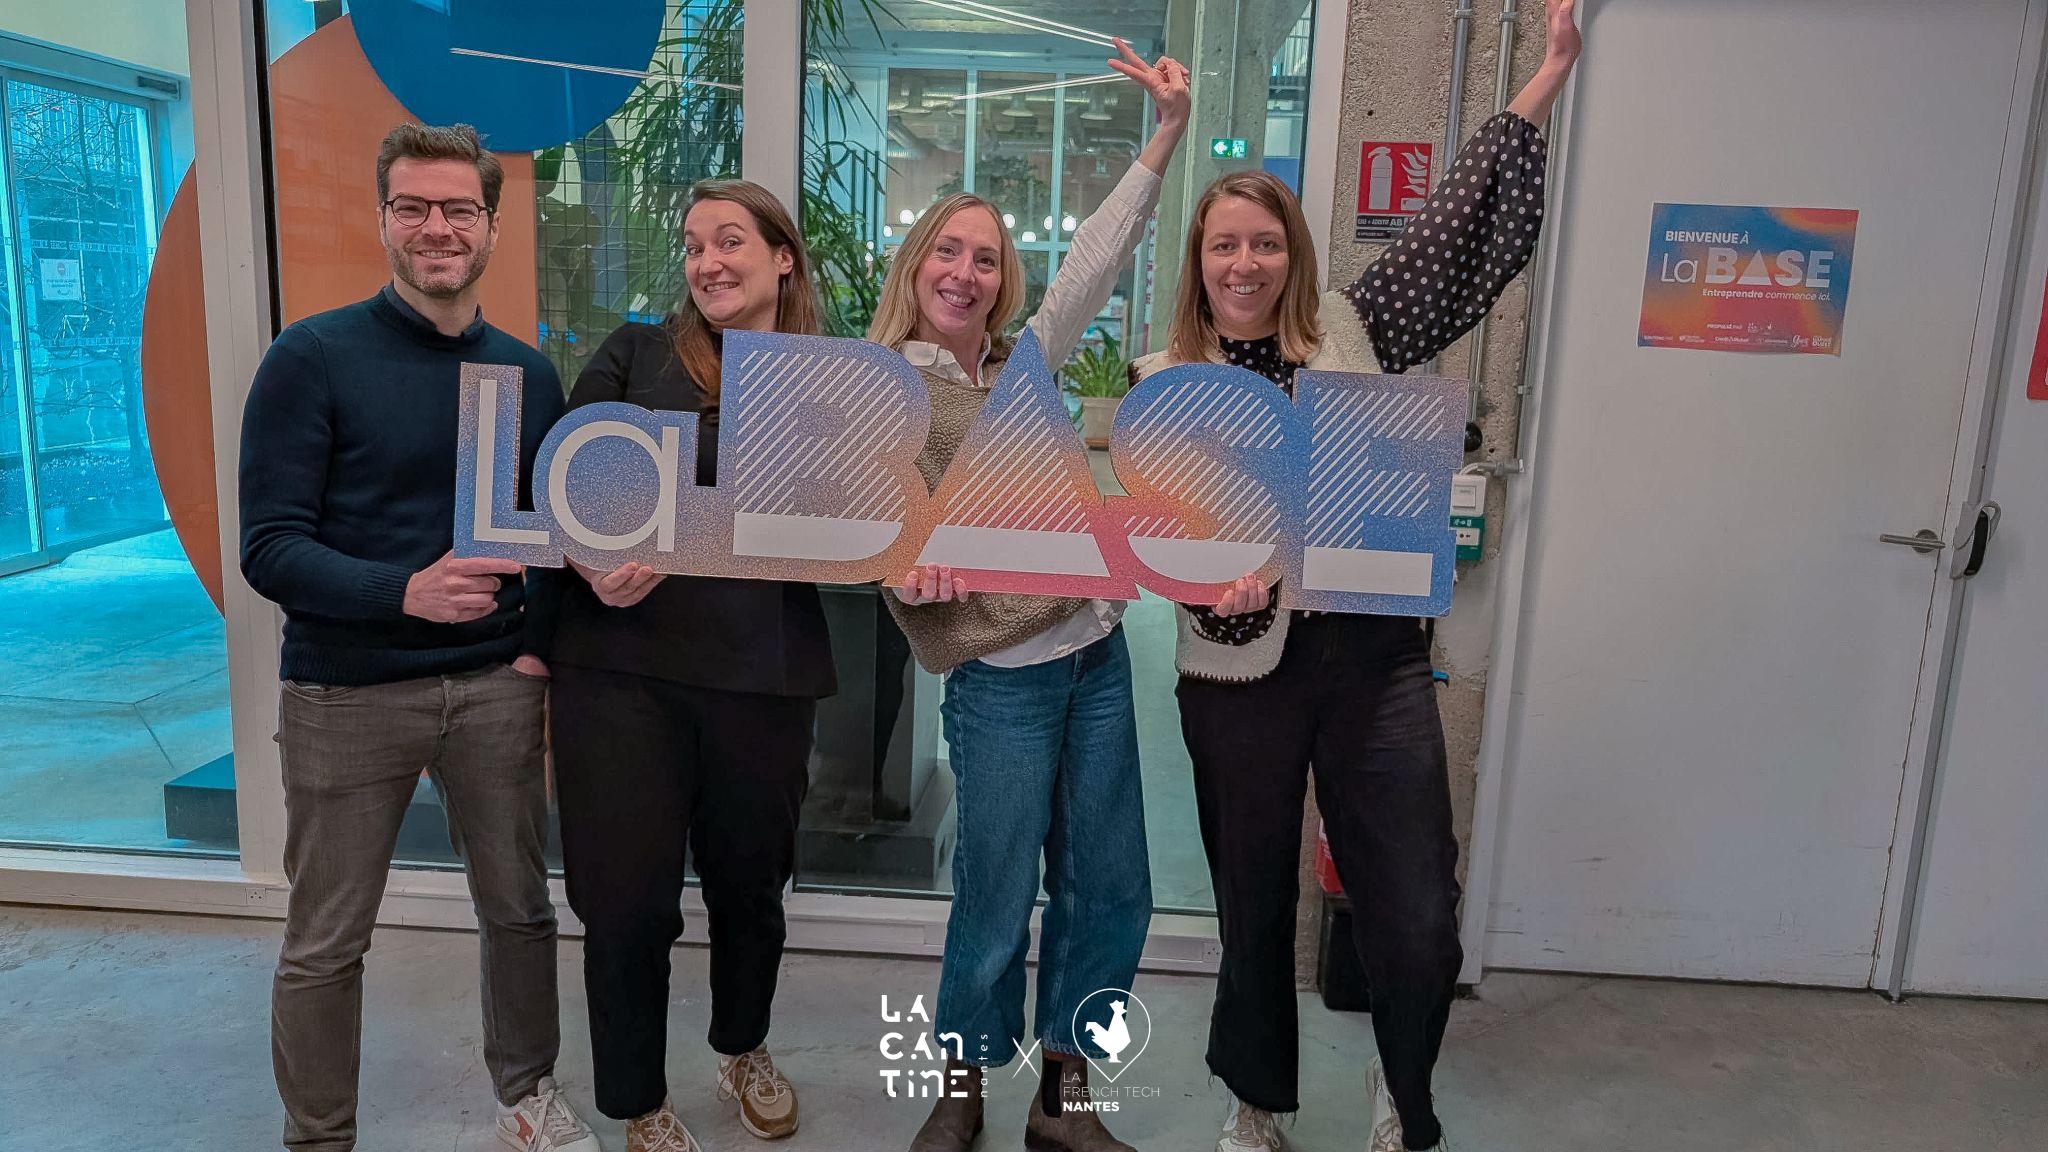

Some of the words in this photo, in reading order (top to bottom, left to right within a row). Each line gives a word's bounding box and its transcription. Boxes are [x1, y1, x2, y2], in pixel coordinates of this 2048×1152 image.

[1665, 230, 1739, 244] BIENVENUE
[1739, 231, 1749, 244] À
[1661, 252, 1698, 283] La
[1704, 247, 1834, 288] BASE
[1702, 288, 1764, 300] Entreprendre
[1764, 291, 1816, 301] commence
[474, 379, 679, 552] La
[733, 348, 1445, 597] BASE
